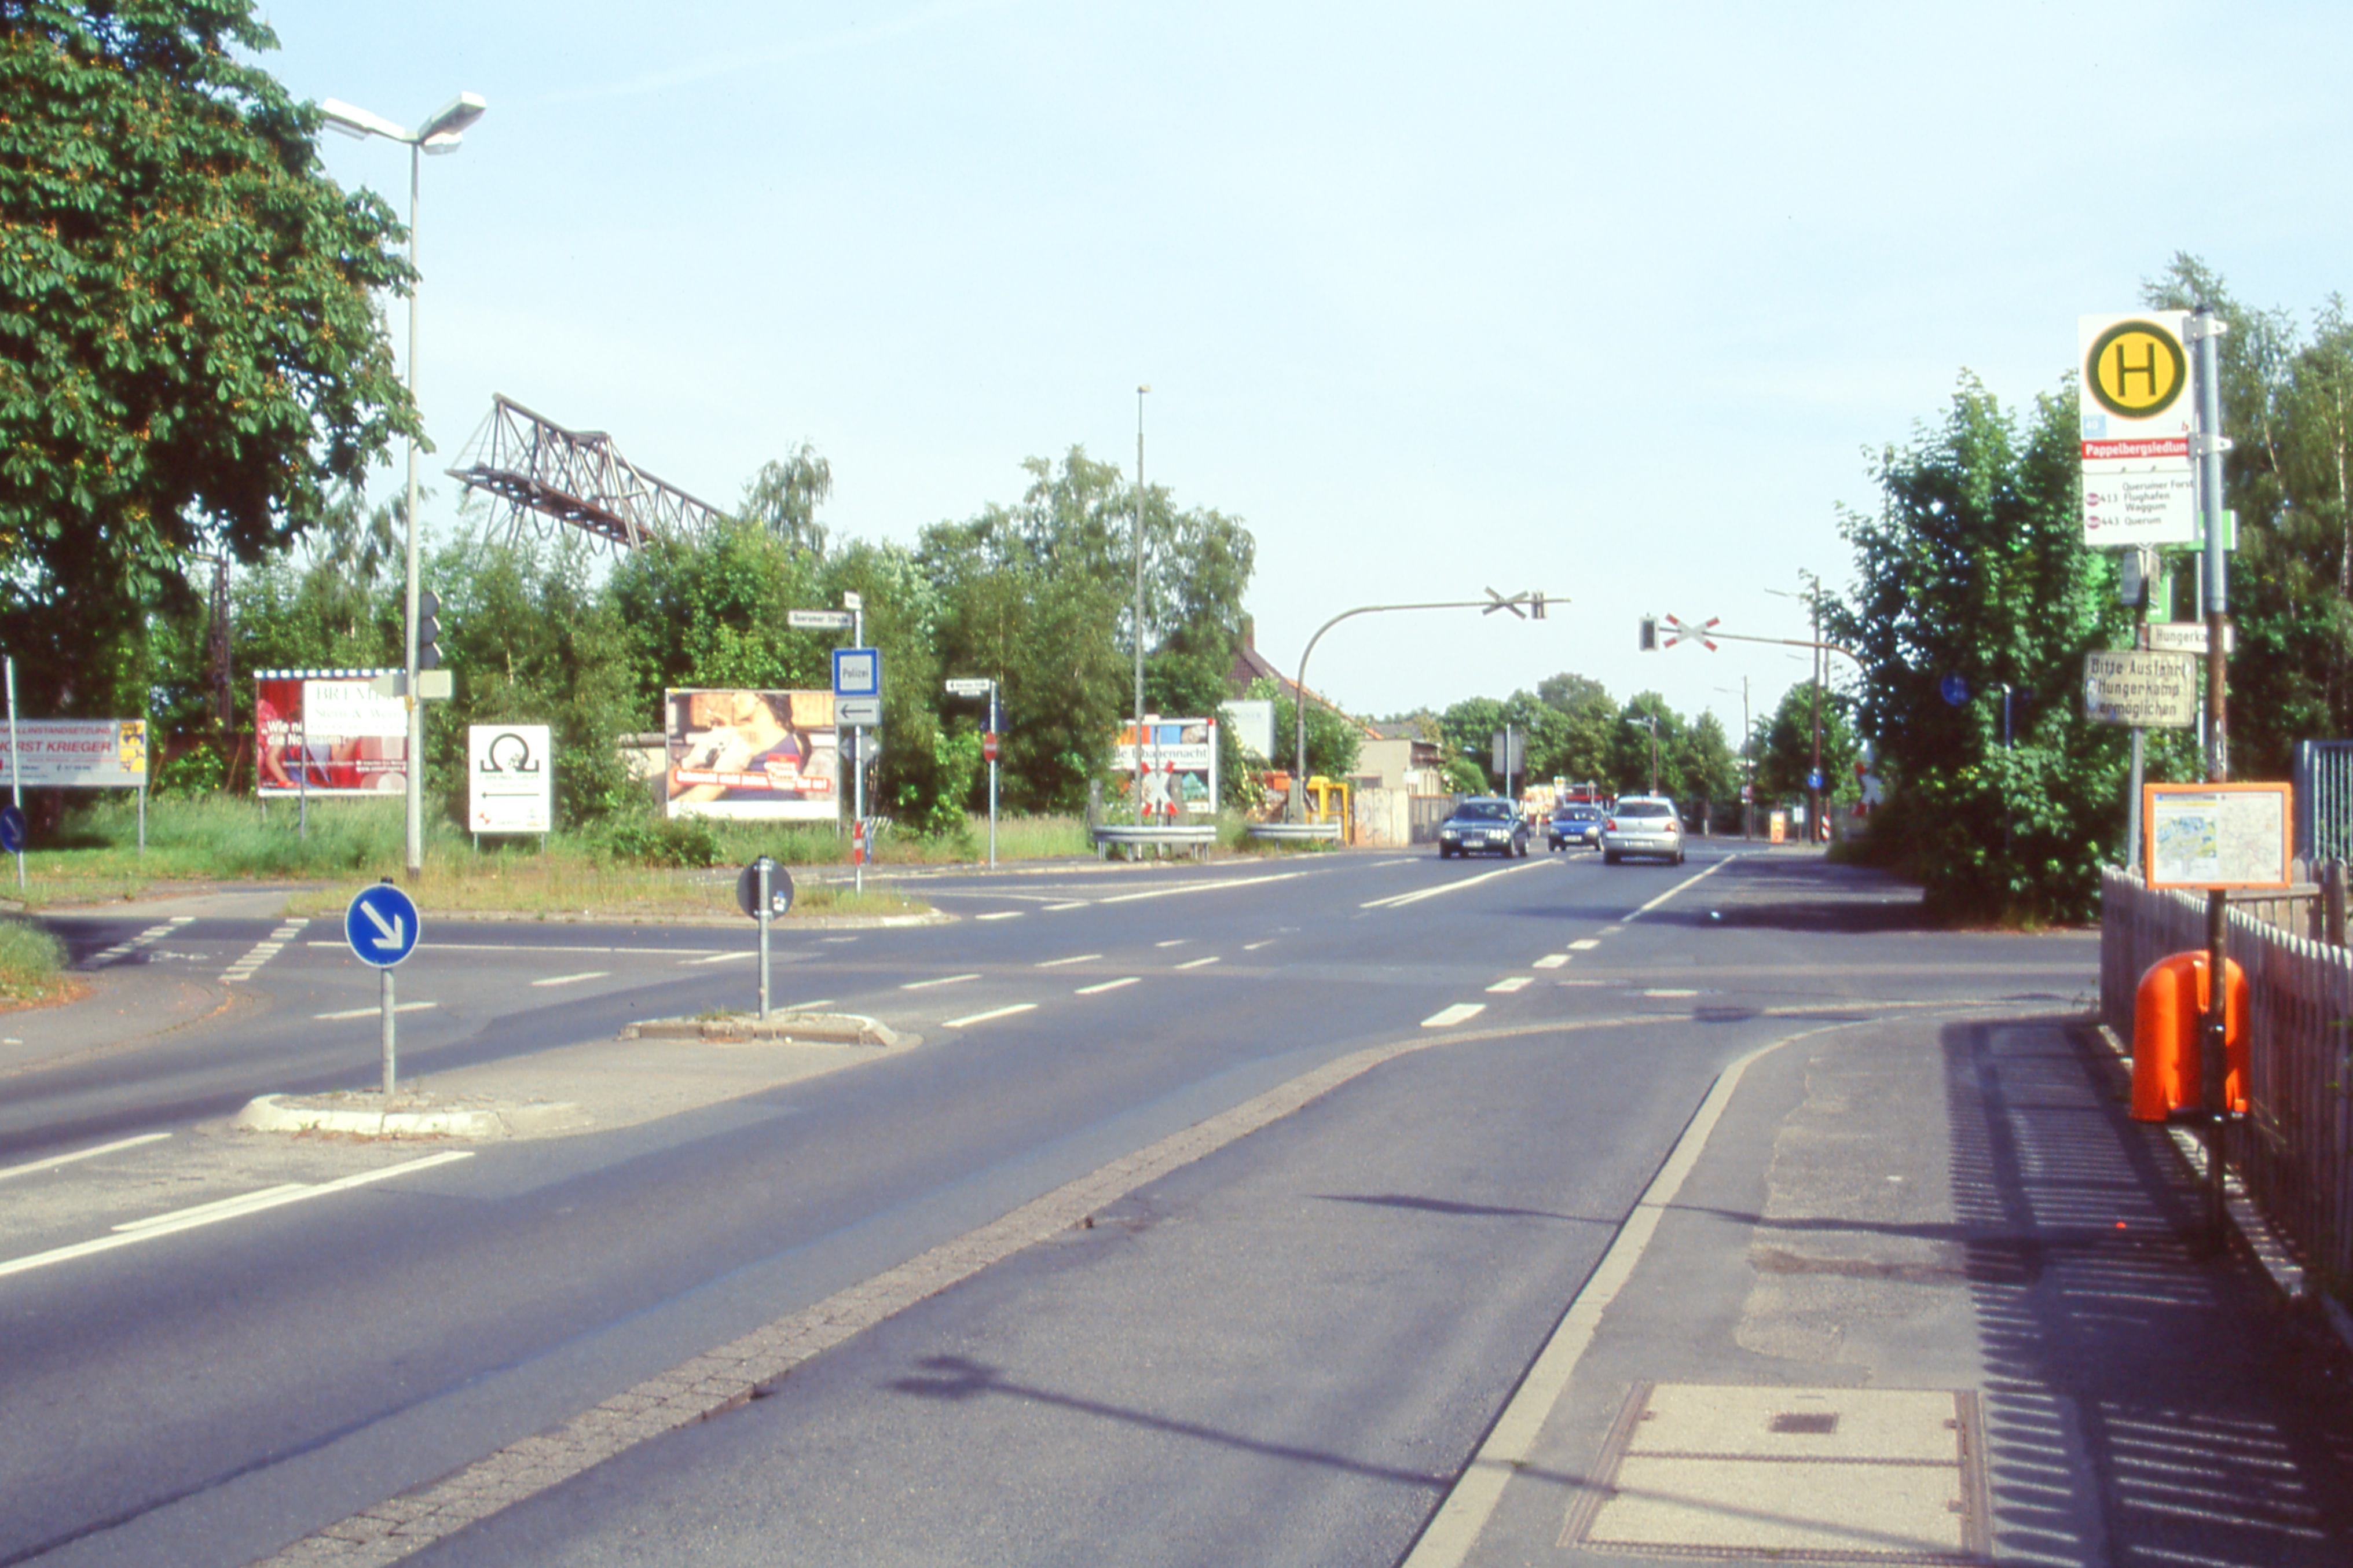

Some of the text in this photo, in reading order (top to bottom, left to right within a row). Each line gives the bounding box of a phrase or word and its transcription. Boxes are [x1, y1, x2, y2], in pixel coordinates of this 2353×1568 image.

[2116, 342, 2156, 397] H
[2086, 442, 2187, 457] Pappelbergsiedlun
[2171, 479, 2194, 489] Forst
[2124, 491, 2170, 502] Flughafen
[2125, 503, 2166, 513] Waggum
[2102, 517, 2119, 526] 443
[2124, 516, 2161, 526] Querum
[2156, 628, 2207, 646] Hungerka
[2091, 658, 2186, 676] Bitte Ausfahrt
[843, 668, 869, 678] Polizei
[2098, 678, 2179, 697] Hungerkamp
[2099, 699, 2177, 718] ermöglichen
[267, 734, 285, 745] die
[47, 741, 112, 752] KRIEGER
